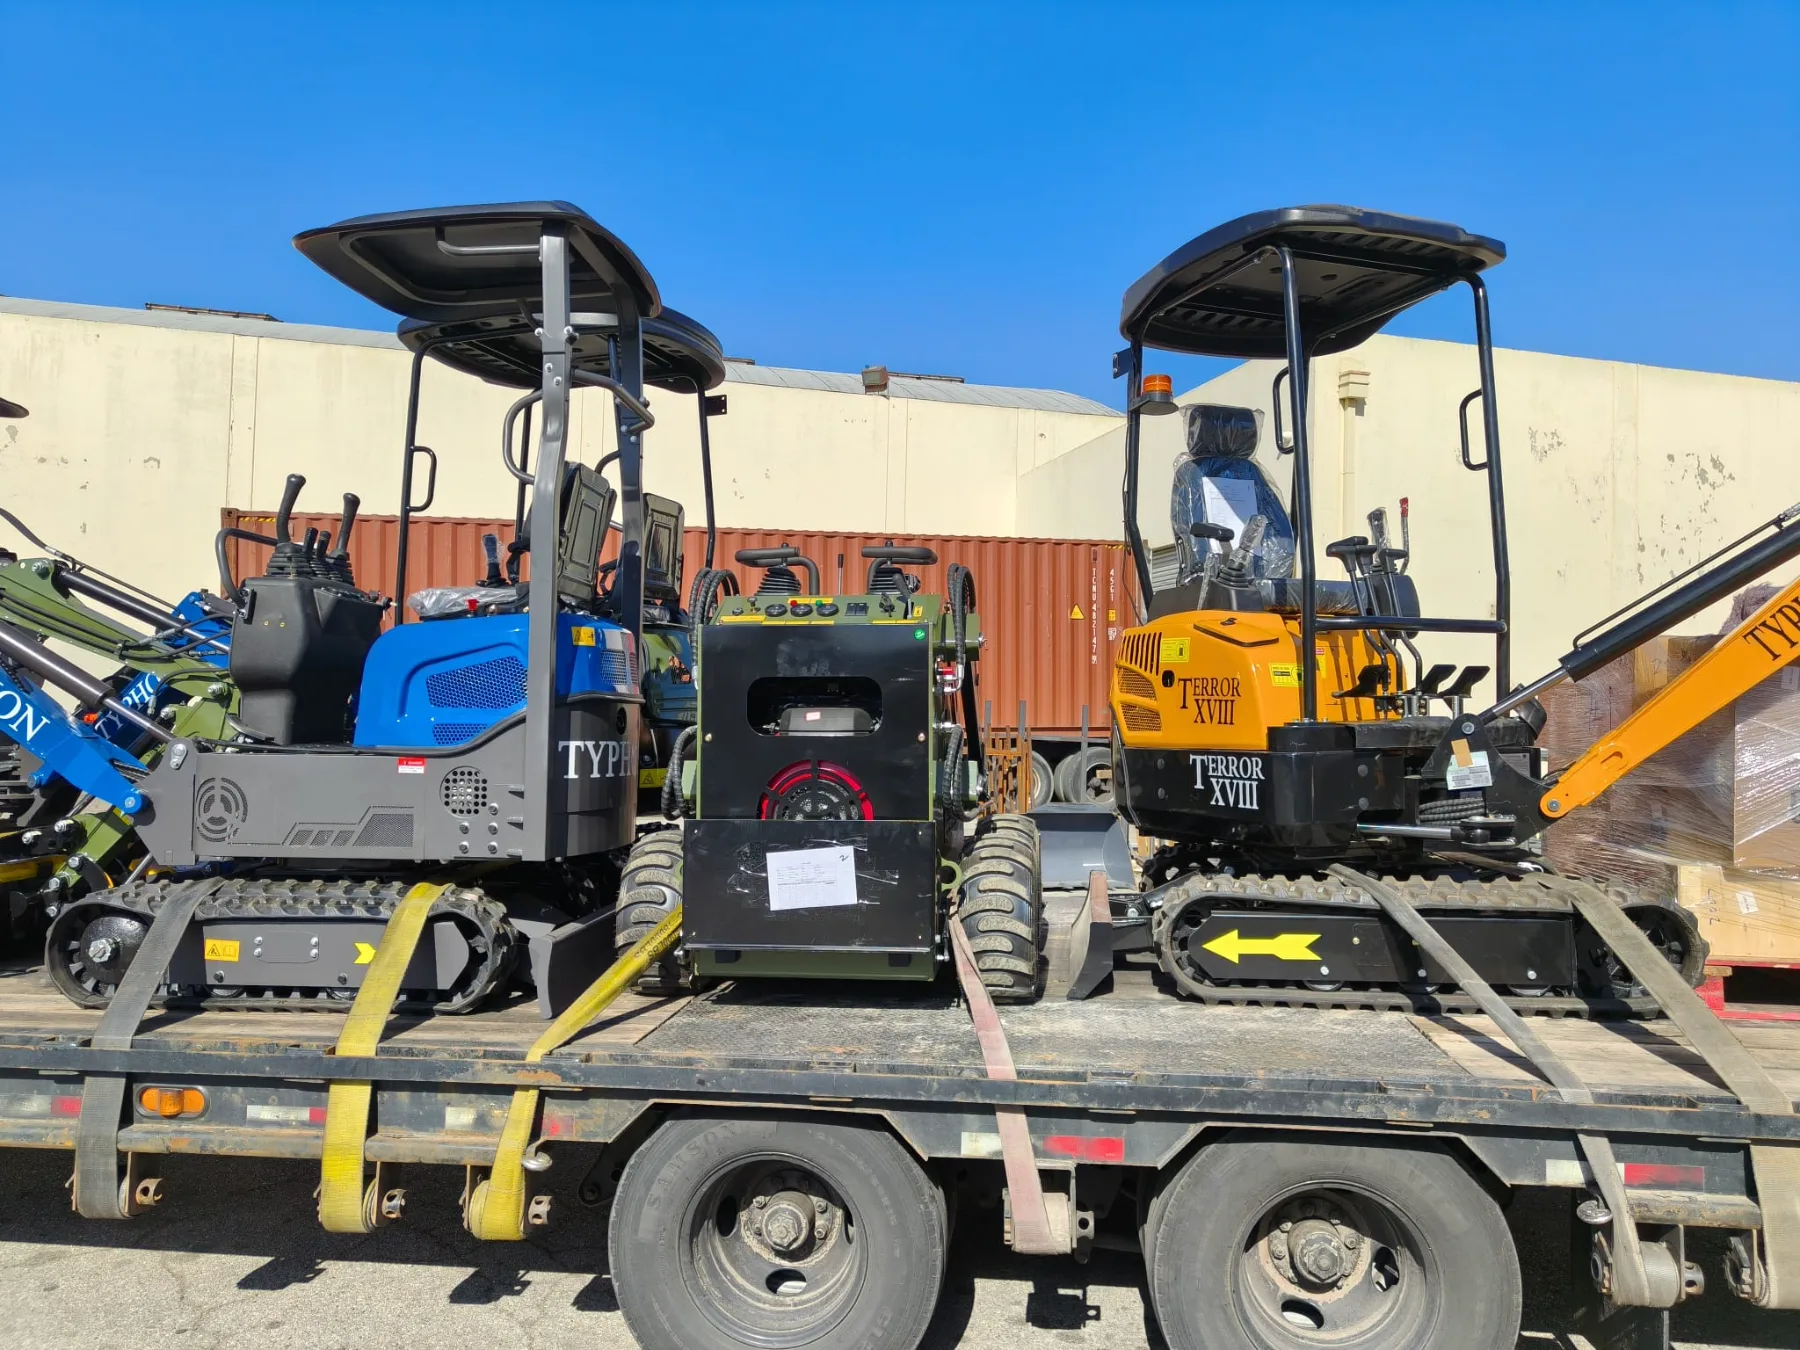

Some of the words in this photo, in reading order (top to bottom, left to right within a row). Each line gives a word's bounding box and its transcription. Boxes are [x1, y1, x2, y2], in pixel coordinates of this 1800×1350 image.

[1741, 596, 1800, 661] TYP
[1178, 677, 1242, 709] TERROR
[0, 681, 51, 742] ON
[1193, 698, 1236, 725] XVIII
[1189, 753, 1266, 790] TERROR
[1209, 777, 1260, 810] XVIII
